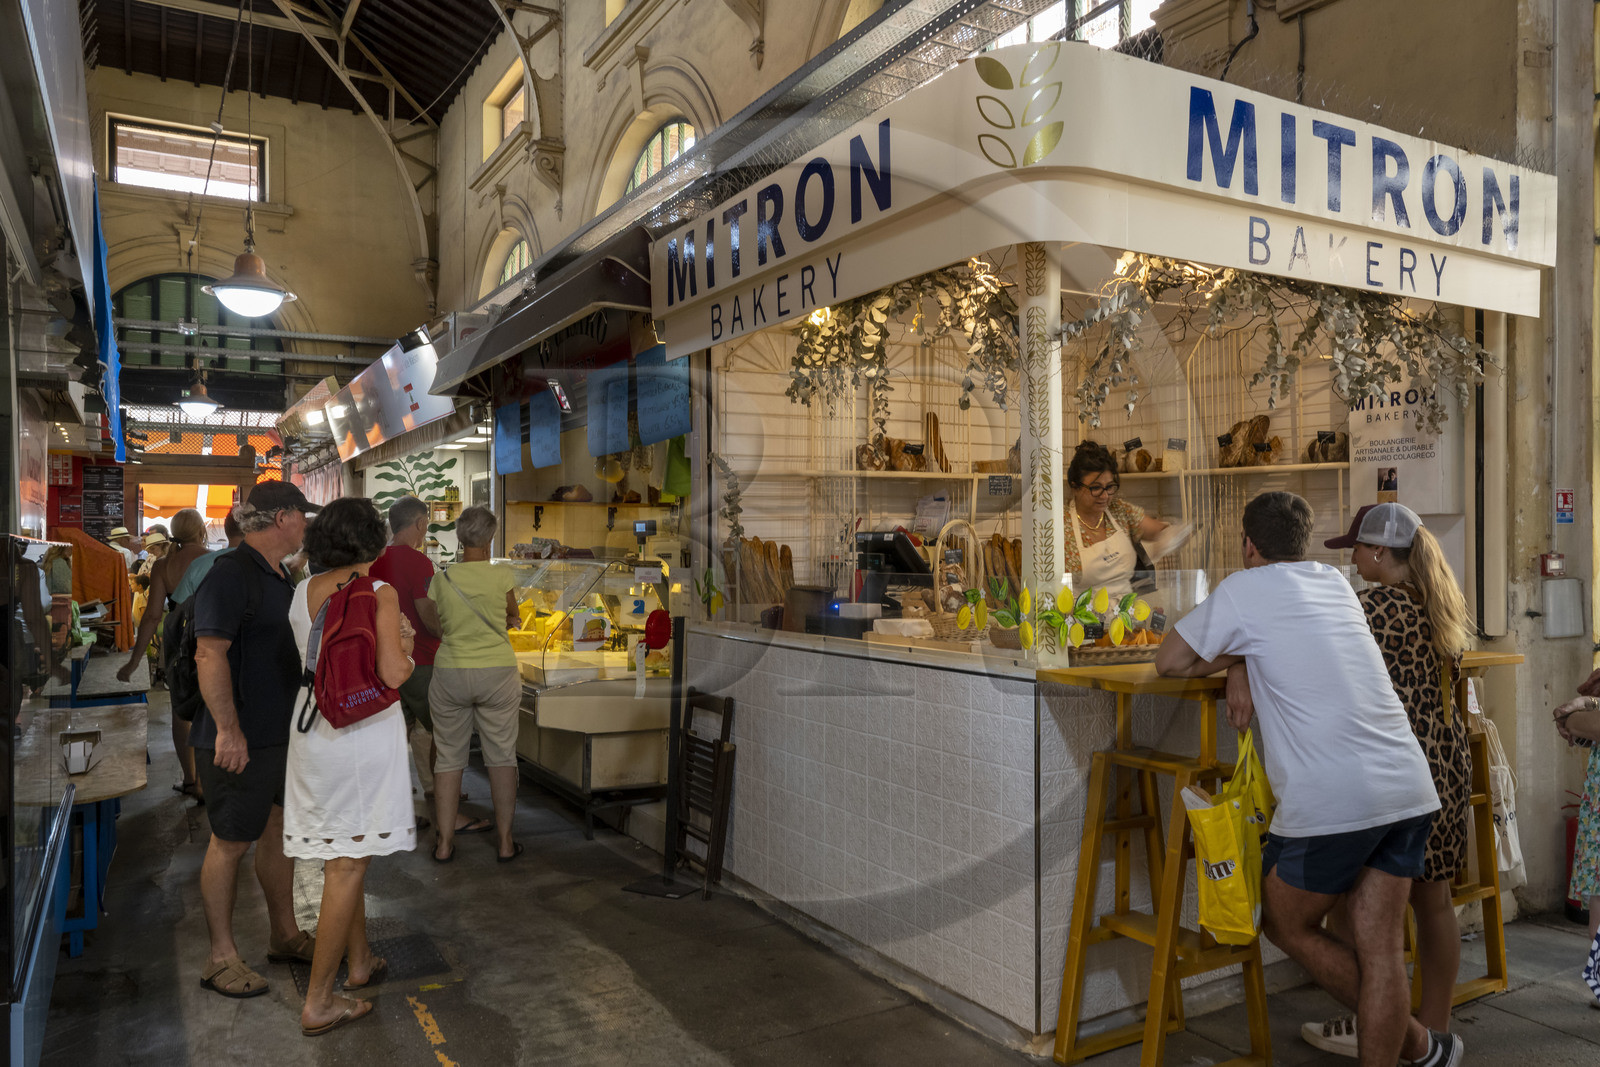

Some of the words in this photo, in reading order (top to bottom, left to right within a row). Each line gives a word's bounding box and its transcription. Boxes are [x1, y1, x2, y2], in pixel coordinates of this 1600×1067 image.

[1186, 85, 1520, 252] MITRON
[667, 118, 892, 307] MITRON
[1248, 216, 1447, 297] BAKERY
[711, 252, 842, 341] BAKERY
[1366, 410, 1418, 423] BAKERY
[1355, 446, 1395, 456] ARTISANALE
[1402, 443, 1434, 452] DURABLE
[1369, 437, 1416, 447] BOULANGERIE
[1368, 454, 1392, 462] MAURO
[1393, 451, 1436, 460] COLAGRECO
[346, 691, 380, 708] ADVENTURE
[348, 688, 376, 701] OUTDOOR
